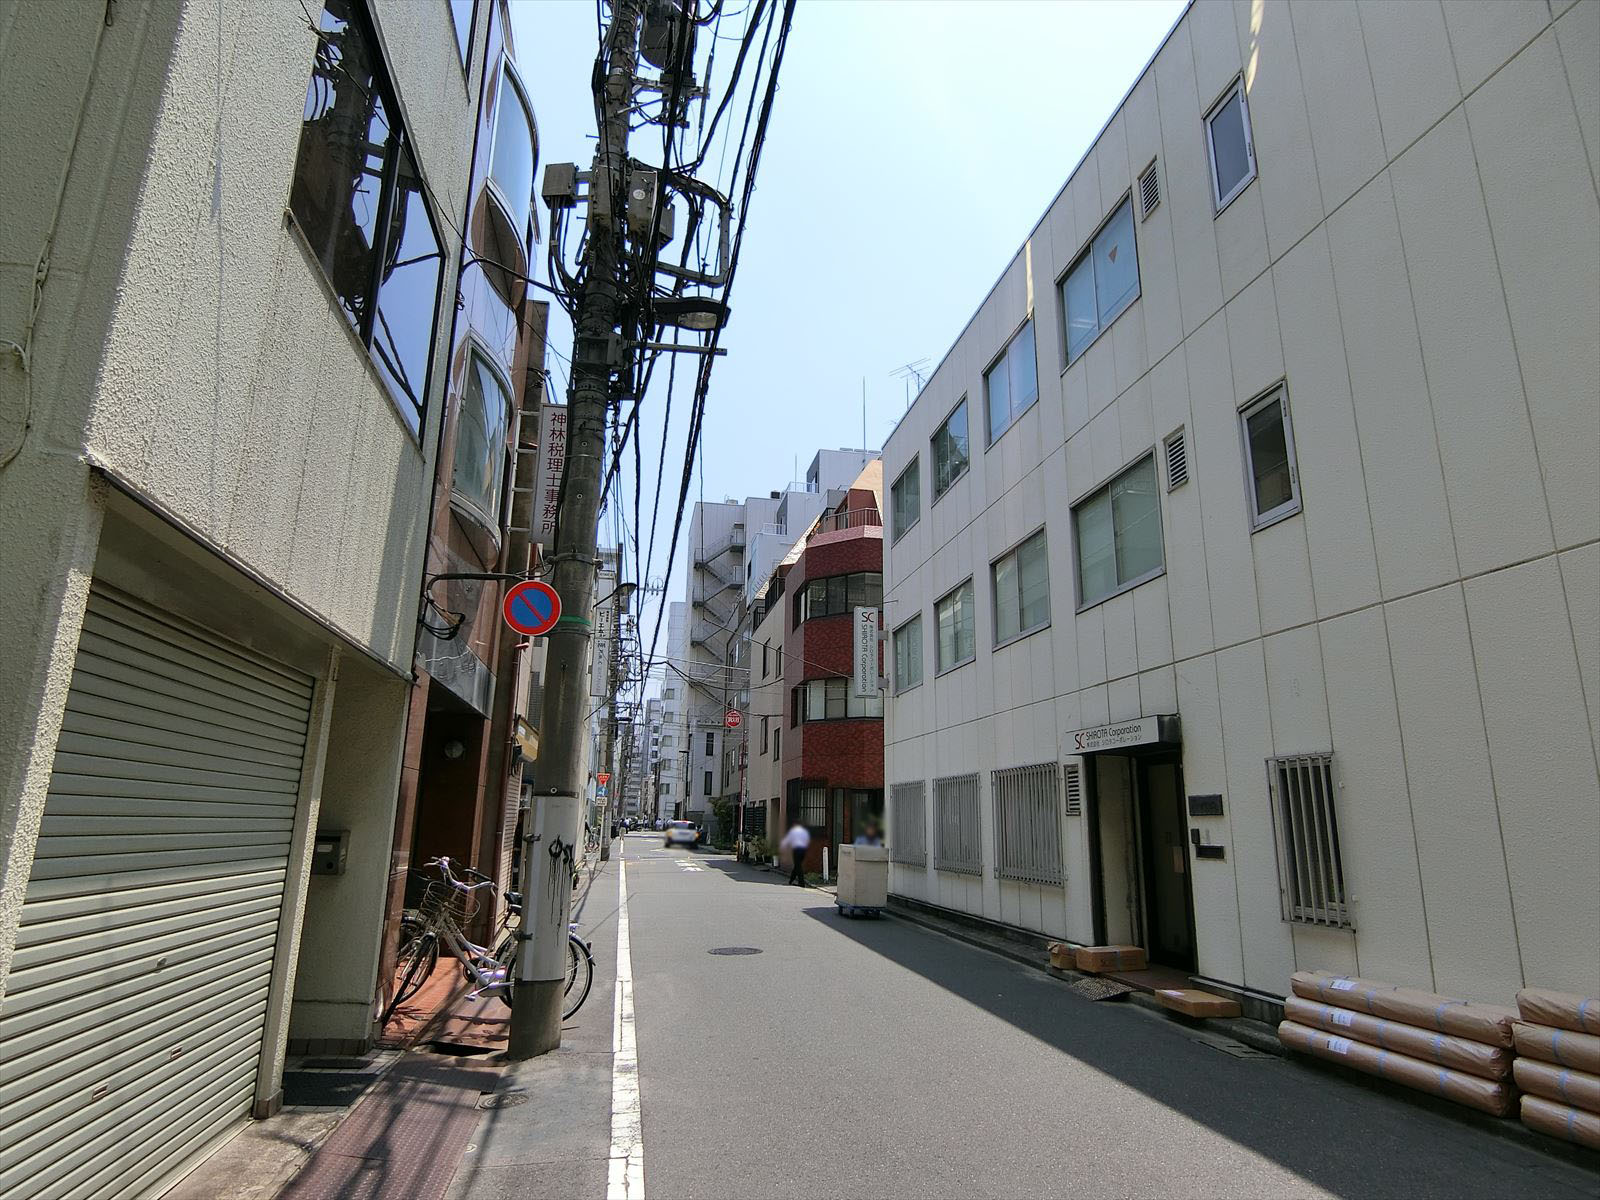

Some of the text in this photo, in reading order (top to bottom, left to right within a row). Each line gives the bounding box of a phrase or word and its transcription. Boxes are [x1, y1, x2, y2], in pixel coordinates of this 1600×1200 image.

[541, 411, 567, 536] 神林税理士事務所
[1086, 725, 1141, 740] SHIROTA Corporation
